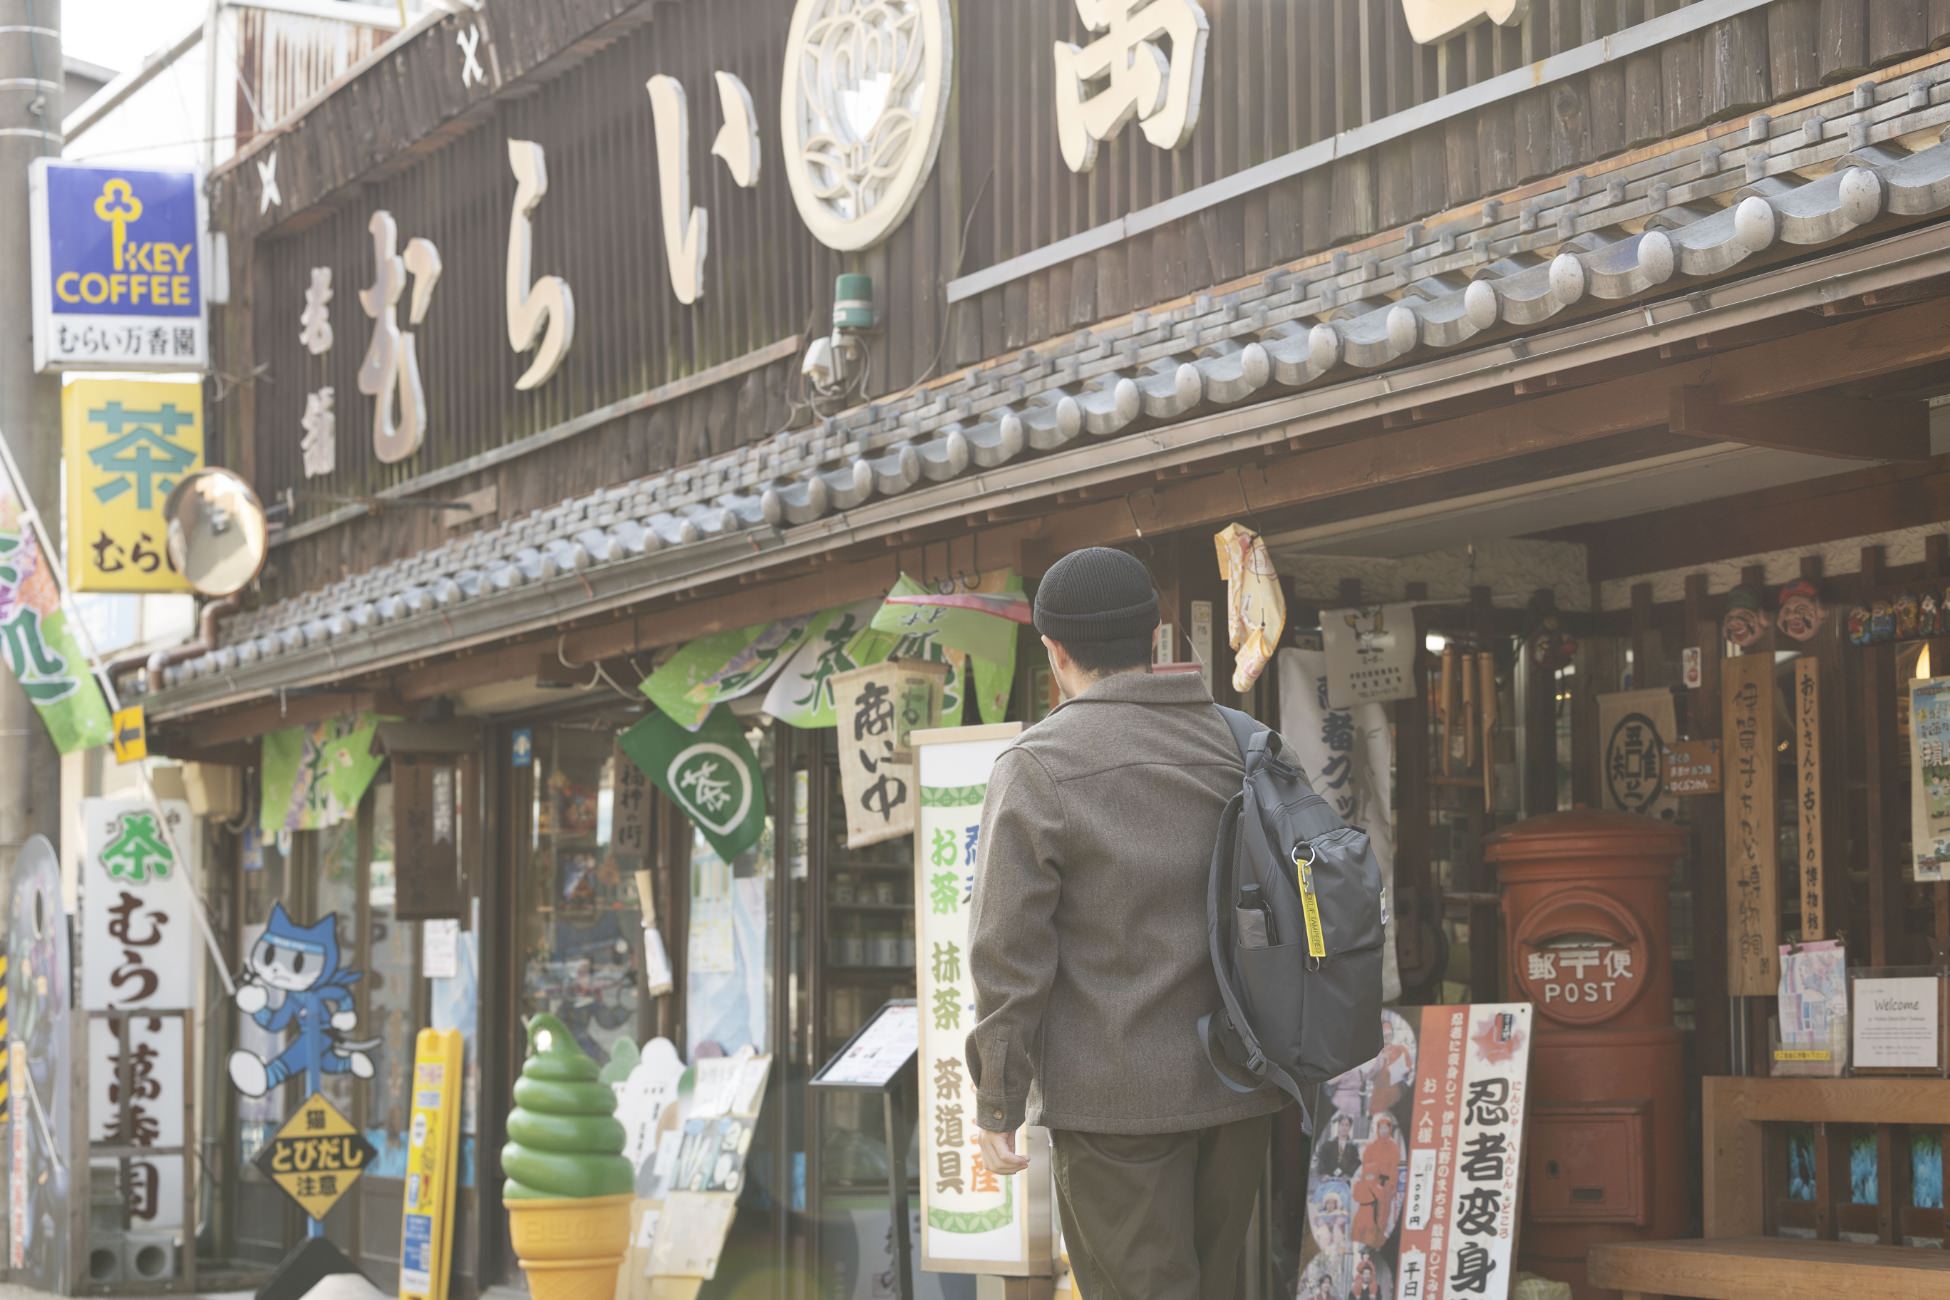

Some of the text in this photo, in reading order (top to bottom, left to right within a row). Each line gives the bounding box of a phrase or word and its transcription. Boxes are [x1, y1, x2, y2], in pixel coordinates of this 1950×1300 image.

[128, 242, 192, 274] KEY
[55, 272, 192, 305] COFFEE
[58, 324, 197, 356] むらい万香園
[87, 401, 199, 510] 茶
[852, 681, 907, 824] 商い中
[101, 811, 174, 882] 茶
[1545, 983, 1616, 1003] POST
[1874, 997, 1920, 1012] Welcome
[930, 827, 965, 1195] お茶 抹茶 茶道具
[272, 1137, 364, 1171] とびだし
[297, 1174, 338, 1197] 注意
[1449, 1077, 1511, 1300] 忍者変身
